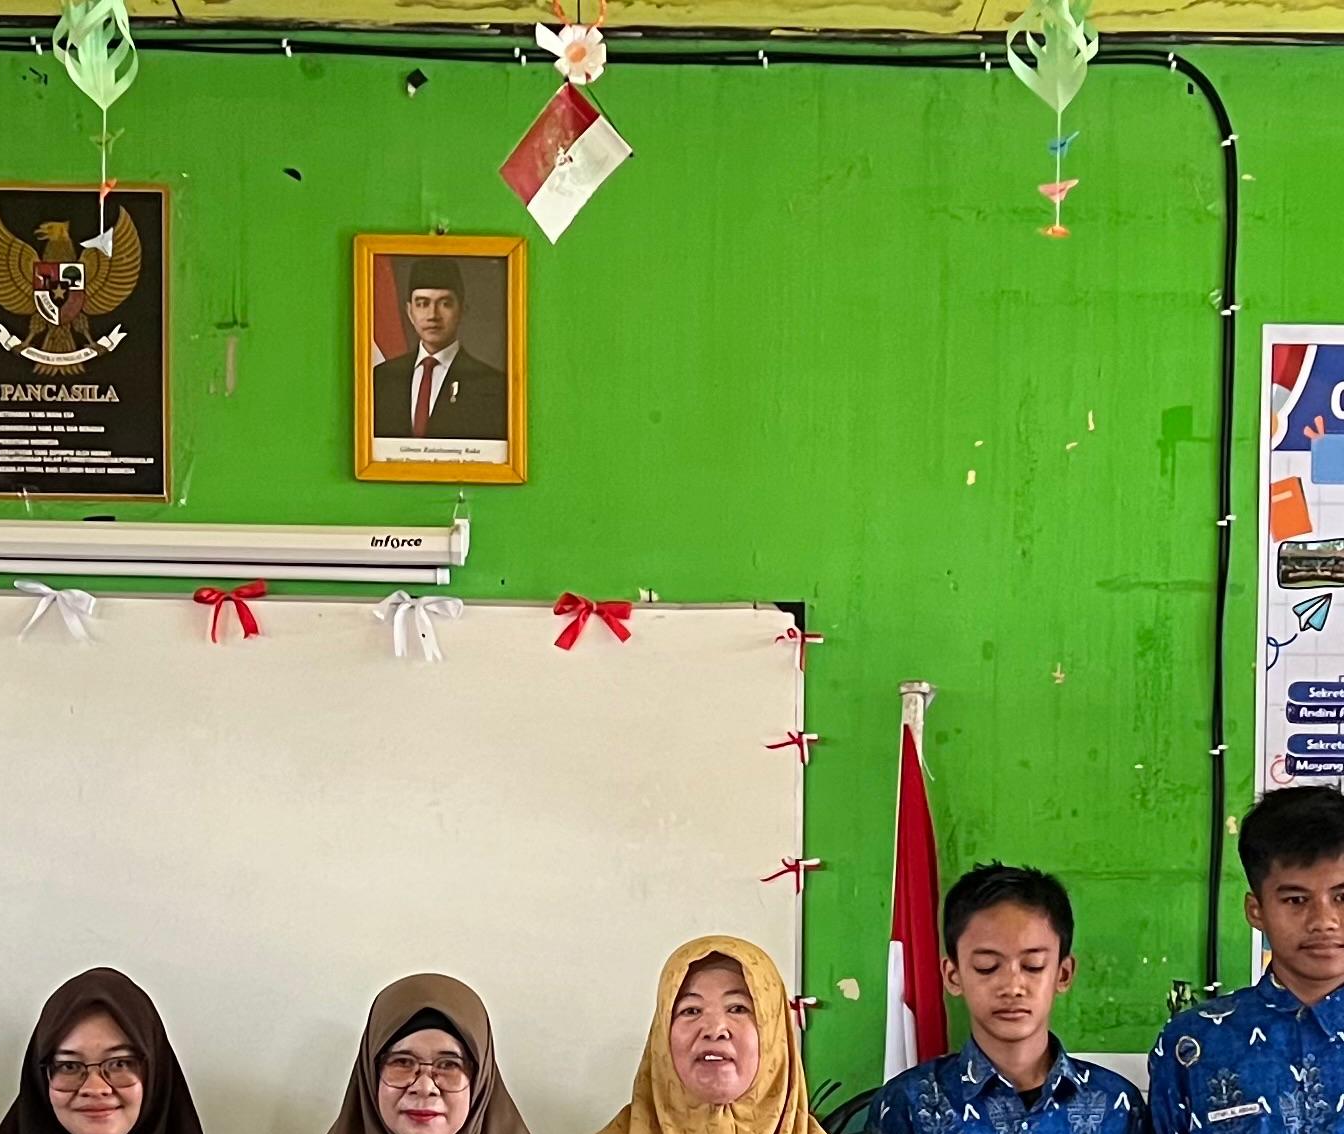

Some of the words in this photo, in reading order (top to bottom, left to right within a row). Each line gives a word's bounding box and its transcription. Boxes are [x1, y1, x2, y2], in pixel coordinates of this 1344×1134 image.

[0, 384, 119, 402] PANCASILA
[370, 535, 422, 548] Inforce
[1300, 707, 1336, 717] Andini
[1296, 760, 1344, 772] Mayang
